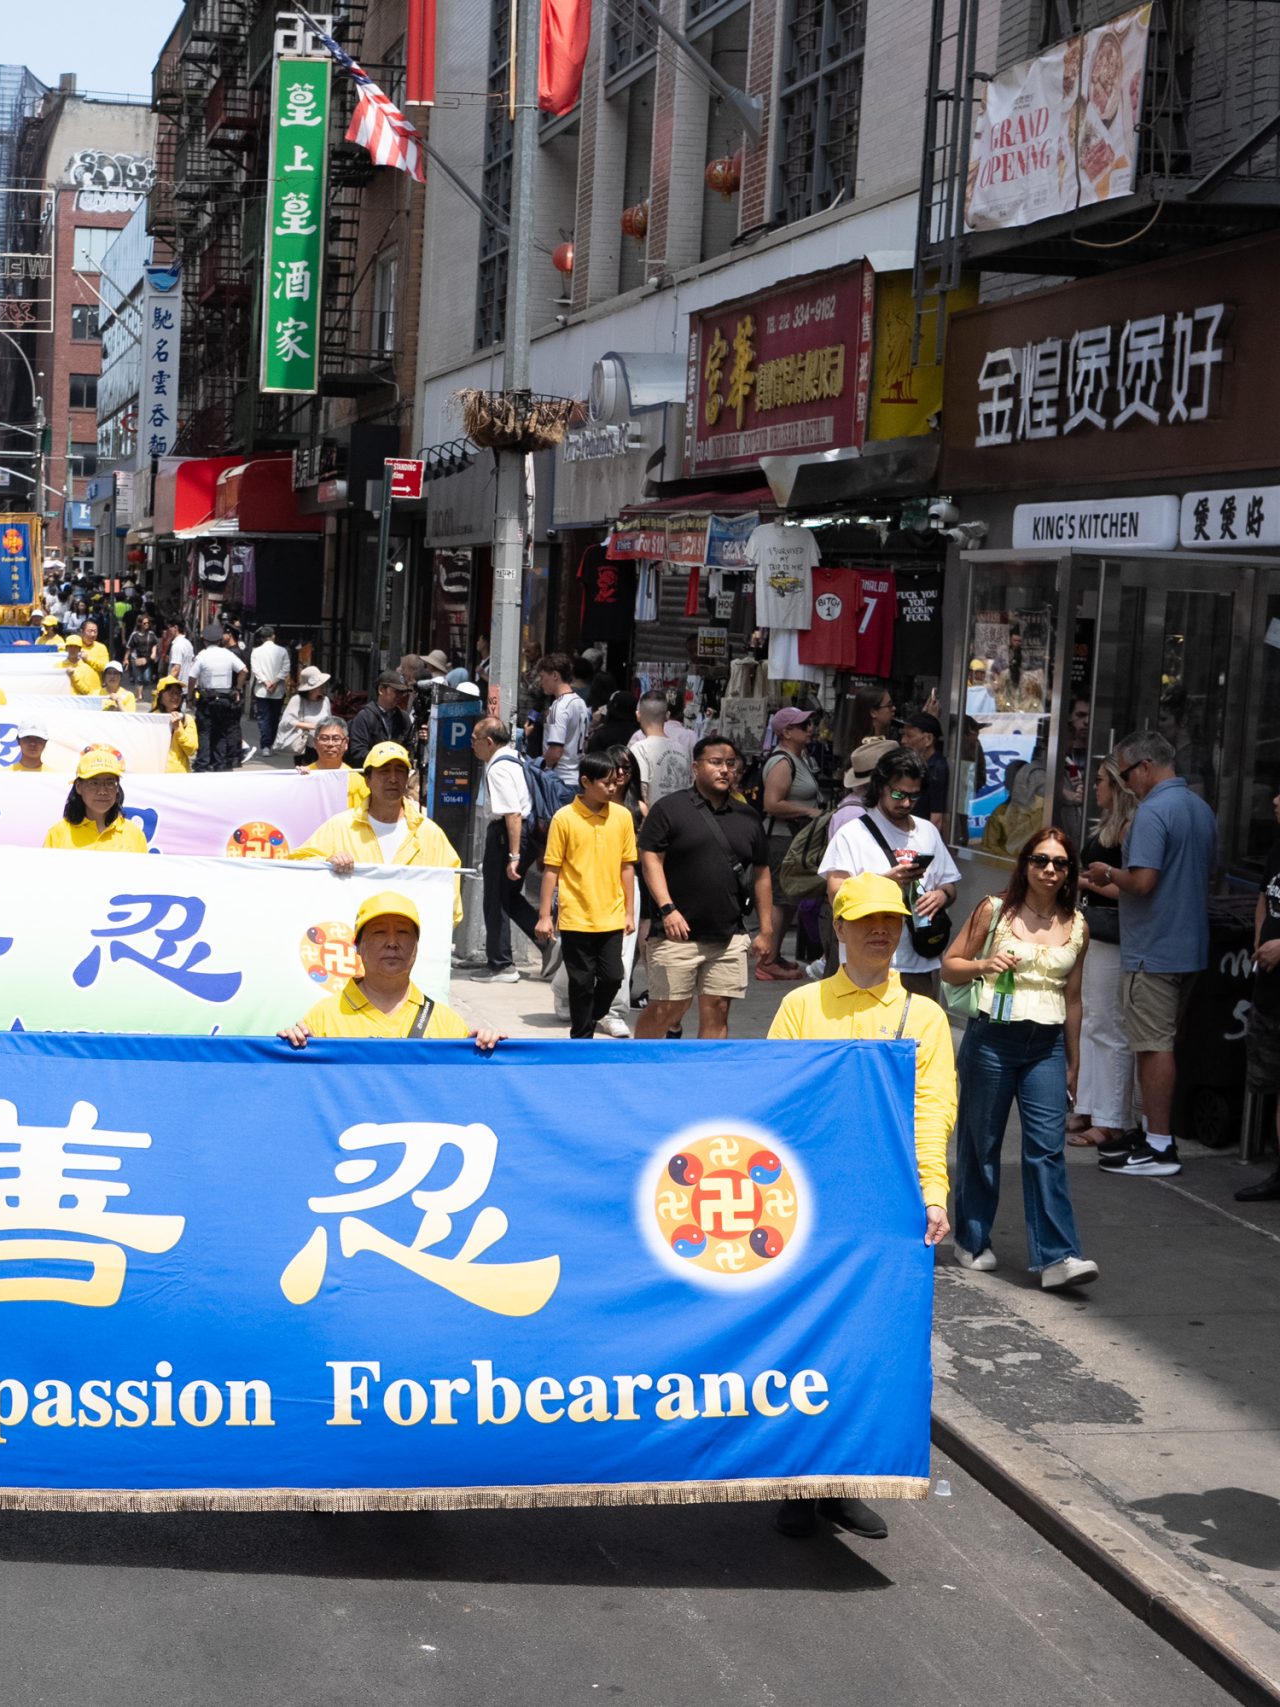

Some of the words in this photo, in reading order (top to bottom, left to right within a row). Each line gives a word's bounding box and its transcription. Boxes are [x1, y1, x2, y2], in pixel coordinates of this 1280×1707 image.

[990, 107, 1049, 150] GRAND
[980, 139, 1052, 188] OPENNG
[792, 294, 837, 329] 334-9162
[975, 303, 1224, 448] 金煌煲煲好
[393, 462, 417, 472] STANDING
[1032, 513, 1075, 541] KING'S
[1078, 511, 1140, 540] KITCHEN
[861, 579, 889, 593] NALDO
[896, 590, 918, 599] FUCK
[920, 589, 938, 598] YOU
[825, 607, 832, 617] 1
[858, 596, 878, 634] 7
[908, 598, 927, 607] YOU
[905, 614, 931, 623] FUCK
[451, 722, 467, 746] P
[326, 1360, 831, 1428] Forbearance
